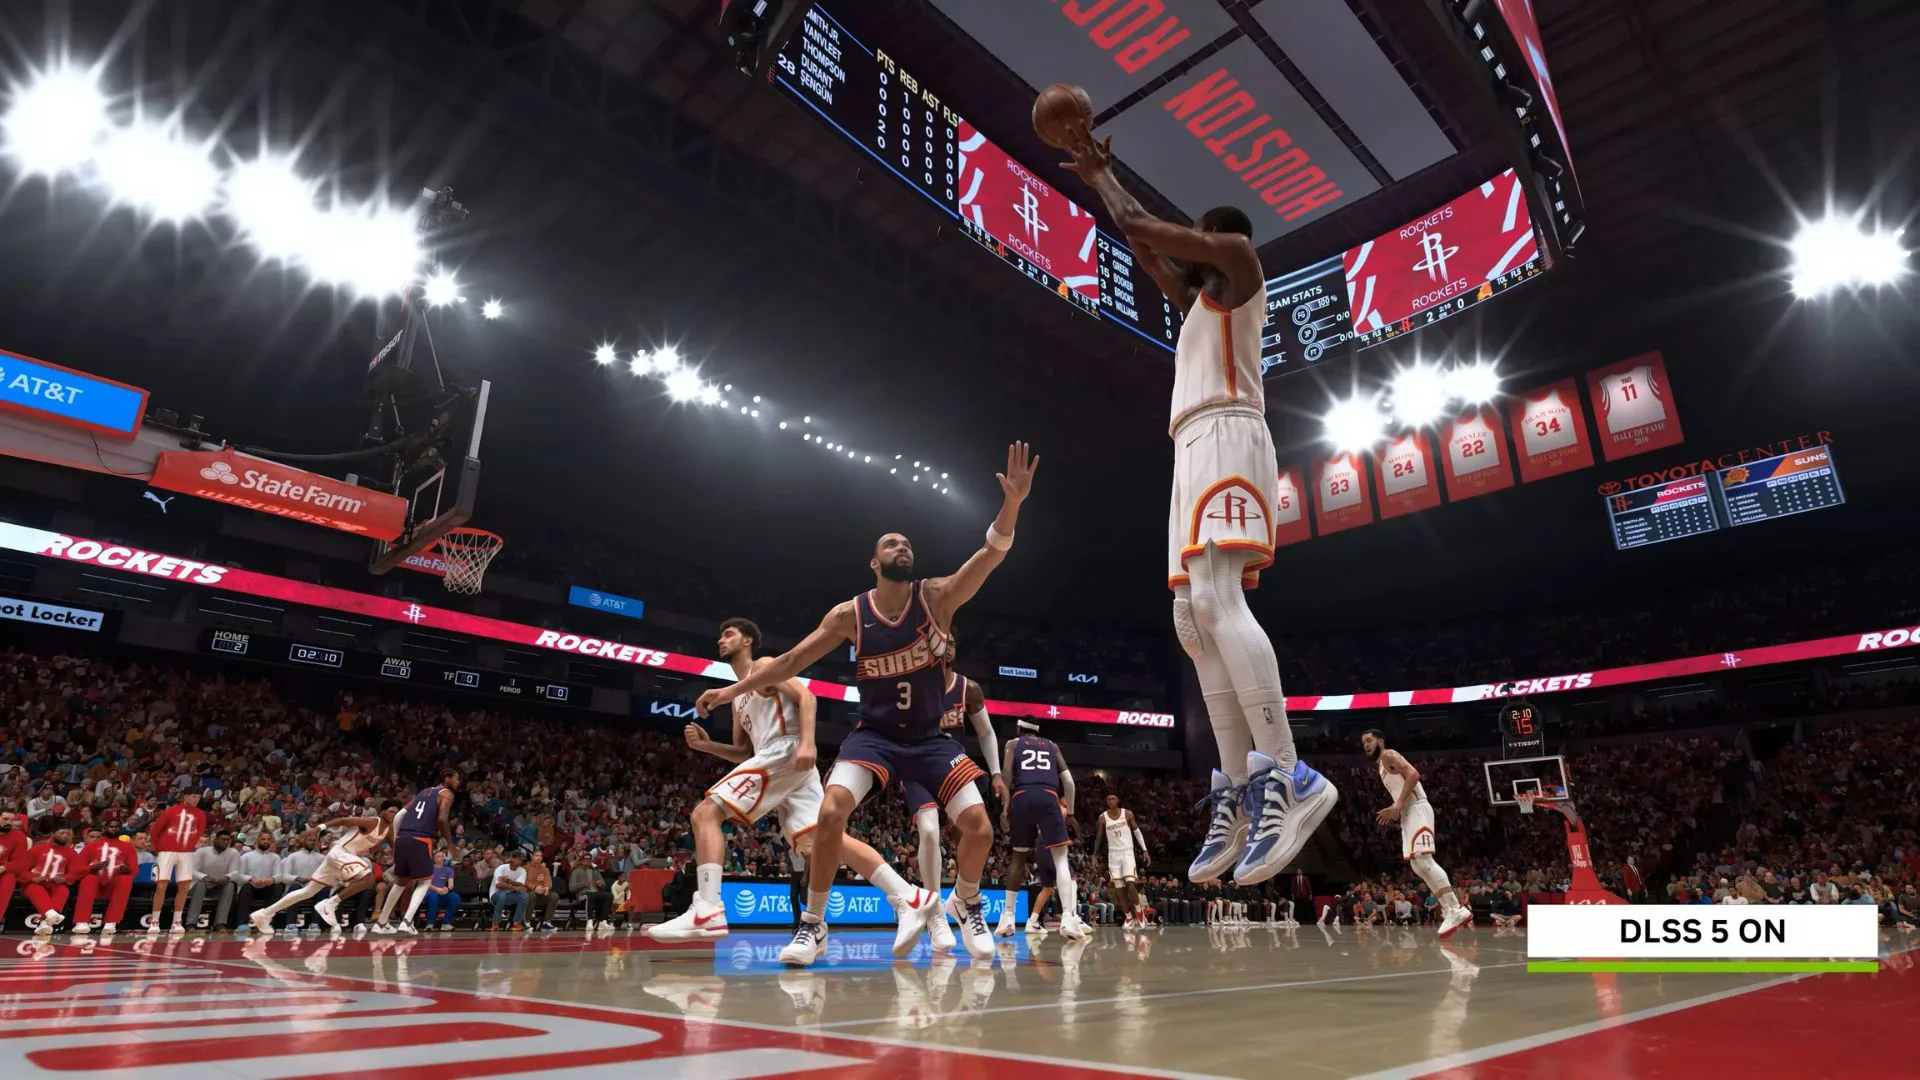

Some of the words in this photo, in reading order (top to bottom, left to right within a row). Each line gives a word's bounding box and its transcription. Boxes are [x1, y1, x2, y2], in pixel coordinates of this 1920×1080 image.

[806, 8, 829, 33] MITH
[879, 72, 888, 85] 0
[926, 111, 933, 123] 0
[946, 127, 953, 139] 0
[803, 20, 842, 62] VANVLEET
[879, 88, 888, 101] 0
[902, 107, 911, 120] 0
[926, 126, 933, 138] 0
[946, 143, 953, 154] 0
[876, 48, 895, 75] PTS
[900, 68, 918, 94] REB
[922, 89, 940, 112] AST
[943, 105, 958, 128] FLS
[802, 36, 845, 83] THOMPSON
[878, 104, 887, 117] 0
[902, 123, 911, 136] 0
[925, 141, 933, 154] 0
[946, 158, 953, 170] 0
[777, 53, 796, 76] 28
[877, 135, 886, 149] 0
[902, 154, 910, 168] 0
[925, 172, 932, 185] 0
[946, 188, 953, 200] 0
[800, 53, 834, 89] DURANT
[877, 119, 886, 134] 2
[902, 139, 910, 152] 0
[925, 156, 933, 169] 0
[946, 173, 953, 185] 0
[1163, 68, 1344, 222] HOUSTON
[1007, 159, 1049, 197] ROCKETS
[1400, 206, 1453, 240] ROCKETS
[1008, 233, 1052, 270] ROCKETS
[1098, 238, 1110, 253] 22
[1100, 265, 1110, 278] 15
[1101, 292, 1113, 307] 25
[1292, 285, 1323, 303] STATS
[1412, 277, 1468, 311] ROCKETS
[1336, 310, 1350, 322] 0/0
[1426, 312, 1434, 323] 2
[1457, 298, 1464, 309] 0
[8, 373, 84, 405] AT&T
[1621, 383, 1638, 402] 11
[1535, 417, 1561, 437] 34
[1462, 439, 1485, 458] 22
[1393, 459, 1415, 478] 24
[1624, 459, 1715, 491] TOYOTA
[1717, 430, 1834, 467] CENTER
[1794, 453, 1828, 466] SUNS
[1330, 479, 1350, 497] 23
[1656, 481, 1706, 498] ROCKETS
[37, 531, 229, 587] ROCKETS
[602, 597, 627, 611] AT&T
[0, 604, 25, 617] ot
[30, 606, 98, 627] Locker
[214, 630, 249, 642] HOME
[535, 630, 668, 667] ROCKETS
[384, 657, 411, 667] AWAY
[443, 671, 455, 681] TF
[535, 685, 545, 694] TF
[896, 682, 912, 710] 3
[1512, 709, 1532, 719] 2:10
[1516, 718, 1533, 734] 15
[1021, 750, 1051, 770] 25
[415, 801, 426, 819] 4
[848, 897, 881, 913] AT&T
